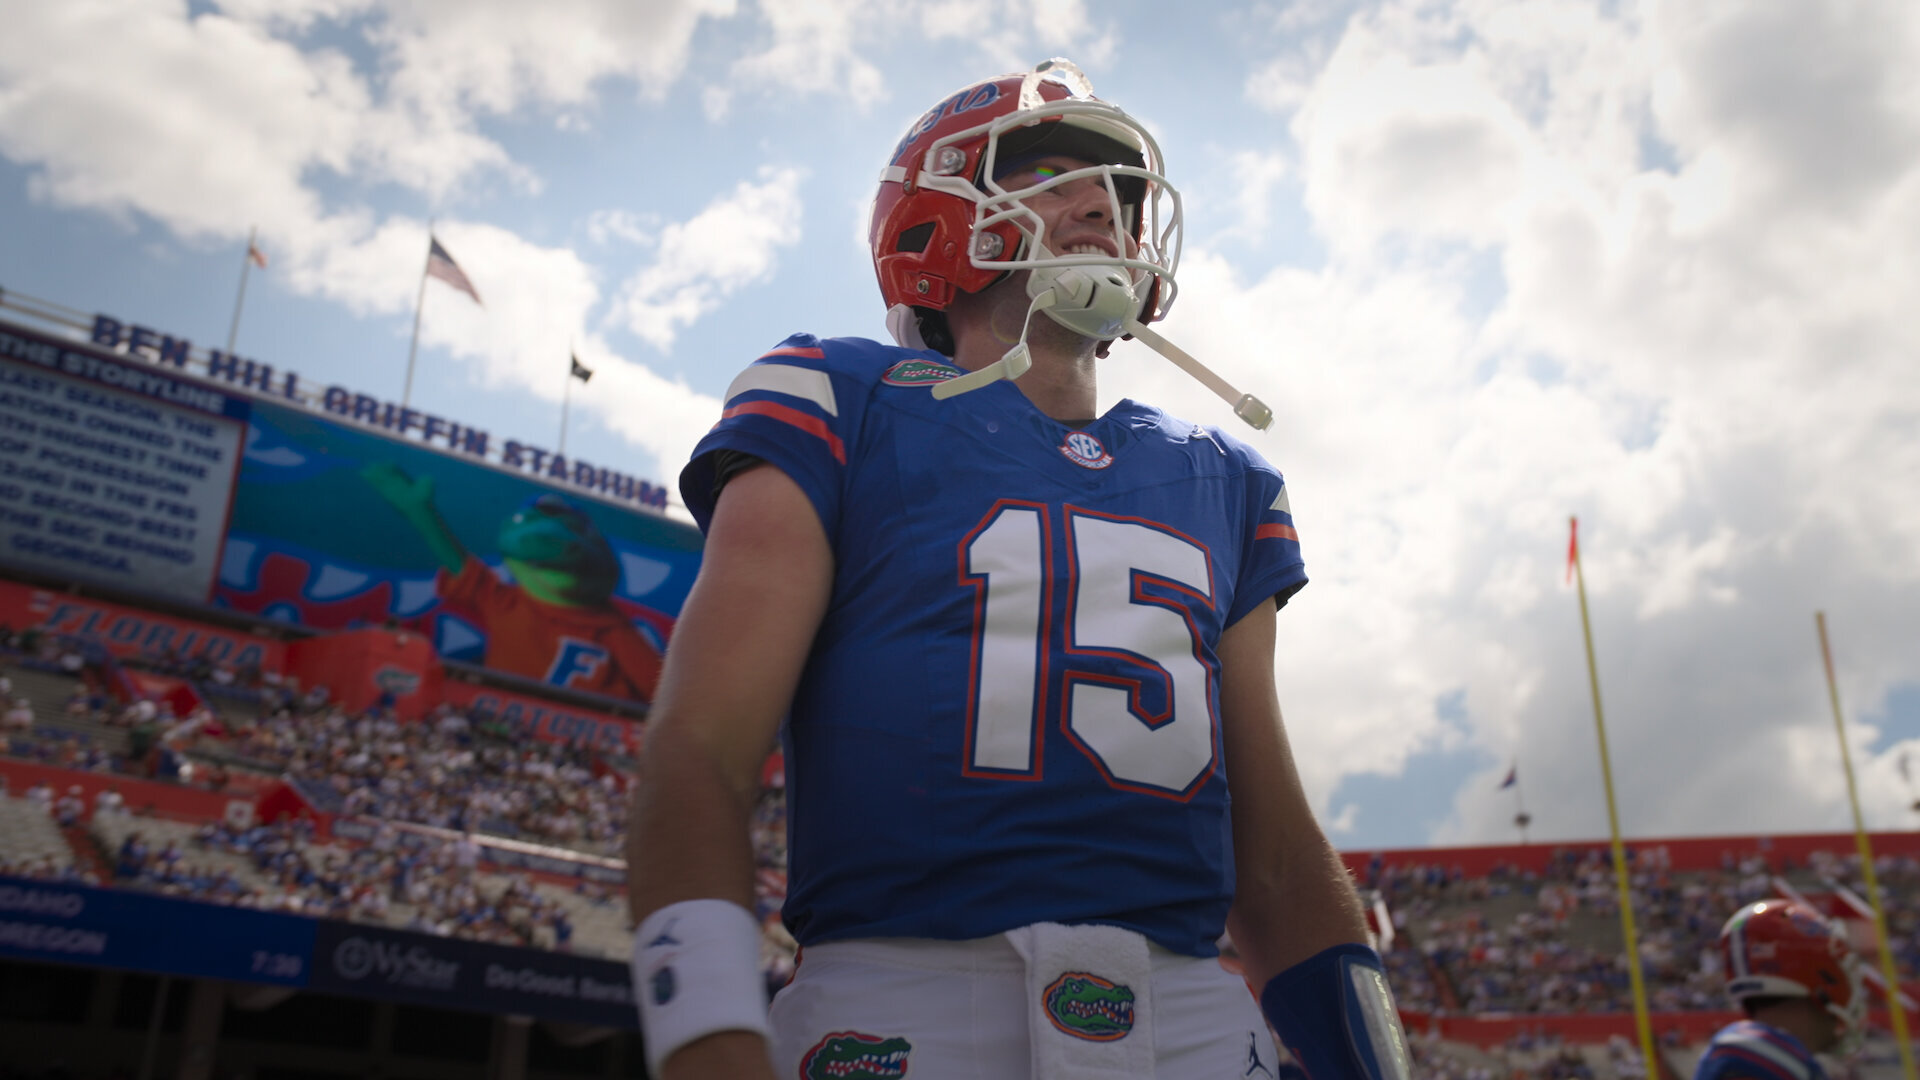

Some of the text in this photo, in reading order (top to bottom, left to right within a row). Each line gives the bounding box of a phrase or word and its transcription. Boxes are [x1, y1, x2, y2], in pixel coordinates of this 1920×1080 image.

[0, 333, 225, 414] THE STORYLINE
[92, 314, 669, 512] BEN HILL GRIFFIN STADIUM
[175, 415, 216, 438] THE
[84, 415, 174, 449] OWNED
[182, 440, 224, 461] THE
[1068, 433, 1102, 460] SEC
[38, 447, 191, 496] POSSESSION
[155, 456, 209, 480] TIME
[69, 479, 98, 496] IN
[104, 484, 148, 508] THE
[154, 499, 199, 522] FBS
[104, 530, 197, 566] BEHIND
[46, 603, 266, 666] FLORIDA
[957, 498, 1217, 803] 15
[542, 636, 609, 688] F
[474, 695, 623, 746] GATORS
[373, 940, 461, 985] VyStar
